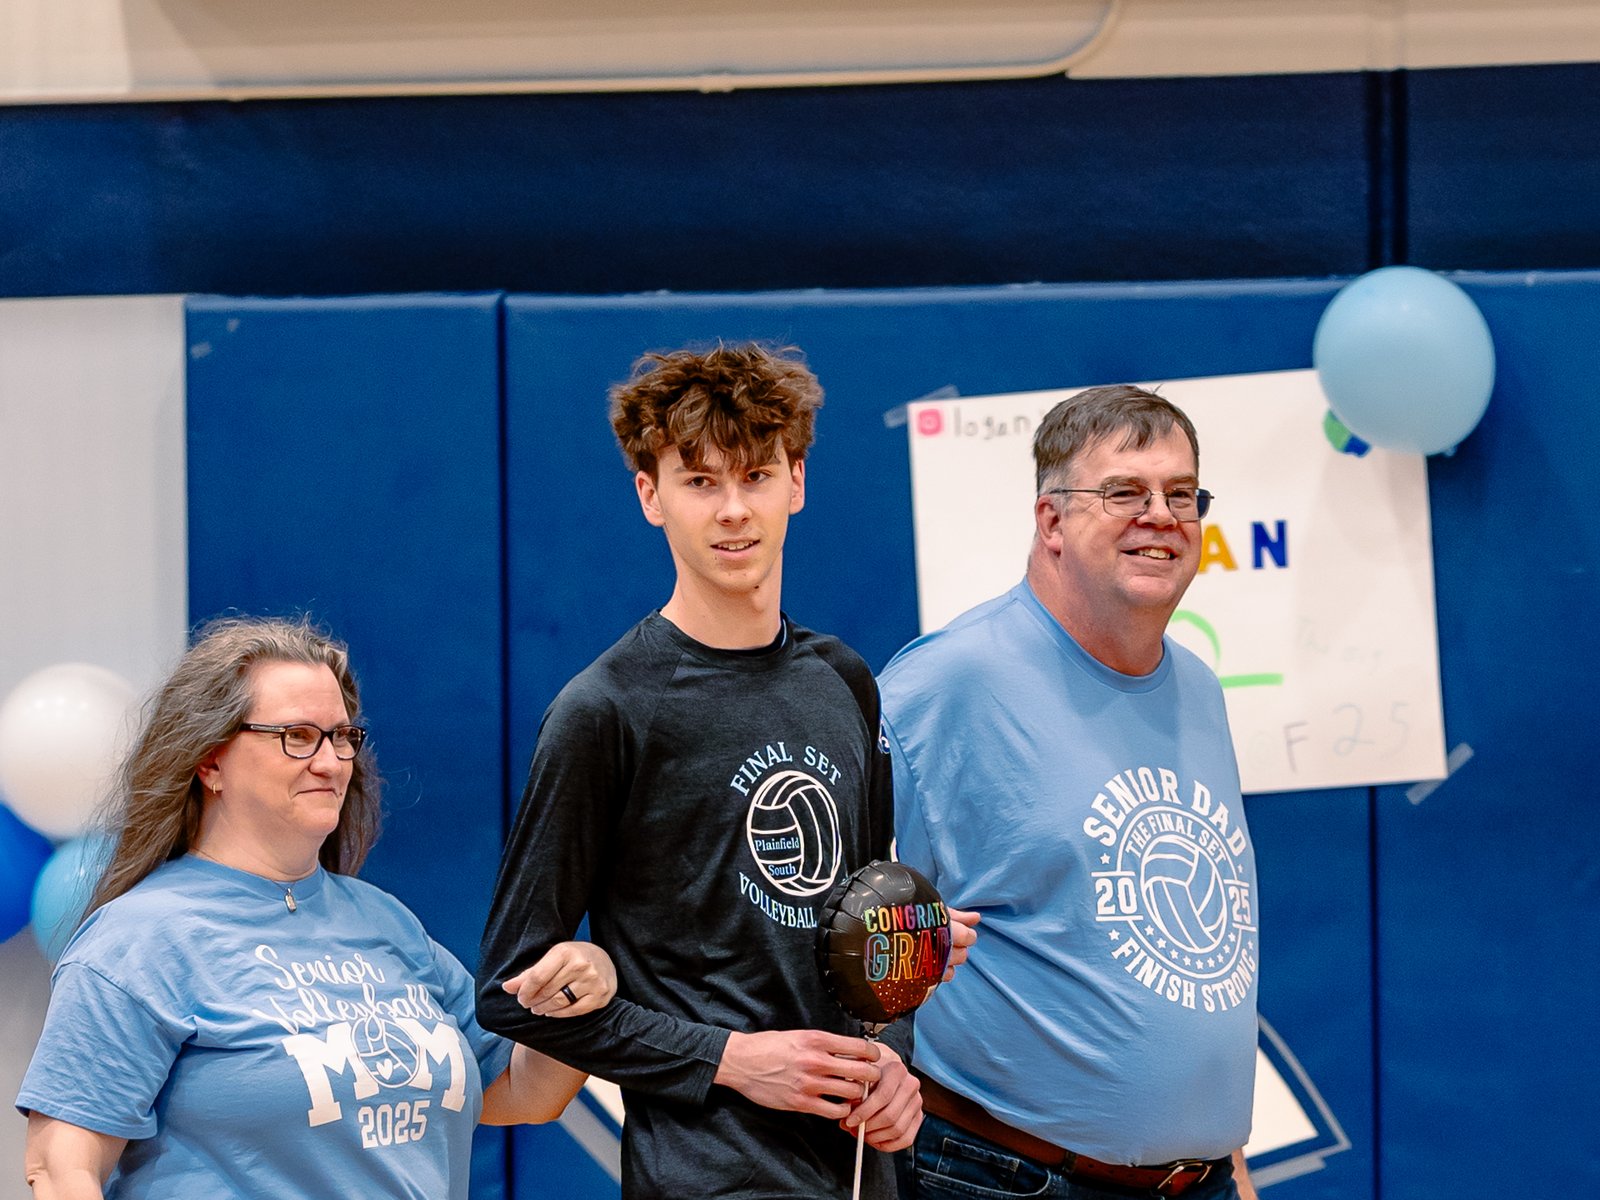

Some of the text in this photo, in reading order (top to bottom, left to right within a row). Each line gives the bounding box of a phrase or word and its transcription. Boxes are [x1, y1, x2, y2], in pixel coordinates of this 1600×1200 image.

[730, 742, 842, 796] FINAL SET
[1083, 766, 1248, 857] SENIOR DAD
[754, 837, 800, 852] Plainfield
[1125, 813, 1227, 864] THE FINAL SET
[768, 862, 797, 877] South
[738, 872, 818, 928] VOLLEYBALL
[864, 902, 948, 933] CONGRATS
[1095, 877, 1252, 925] 20 25
[254, 944, 386, 990] Senior
[865, 927, 951, 981] GRAD
[1111, 936, 1256, 1013] FINISH STRONG
[251, 983, 444, 1041] Volleyball
[358, 1100, 431, 1149] 2025
